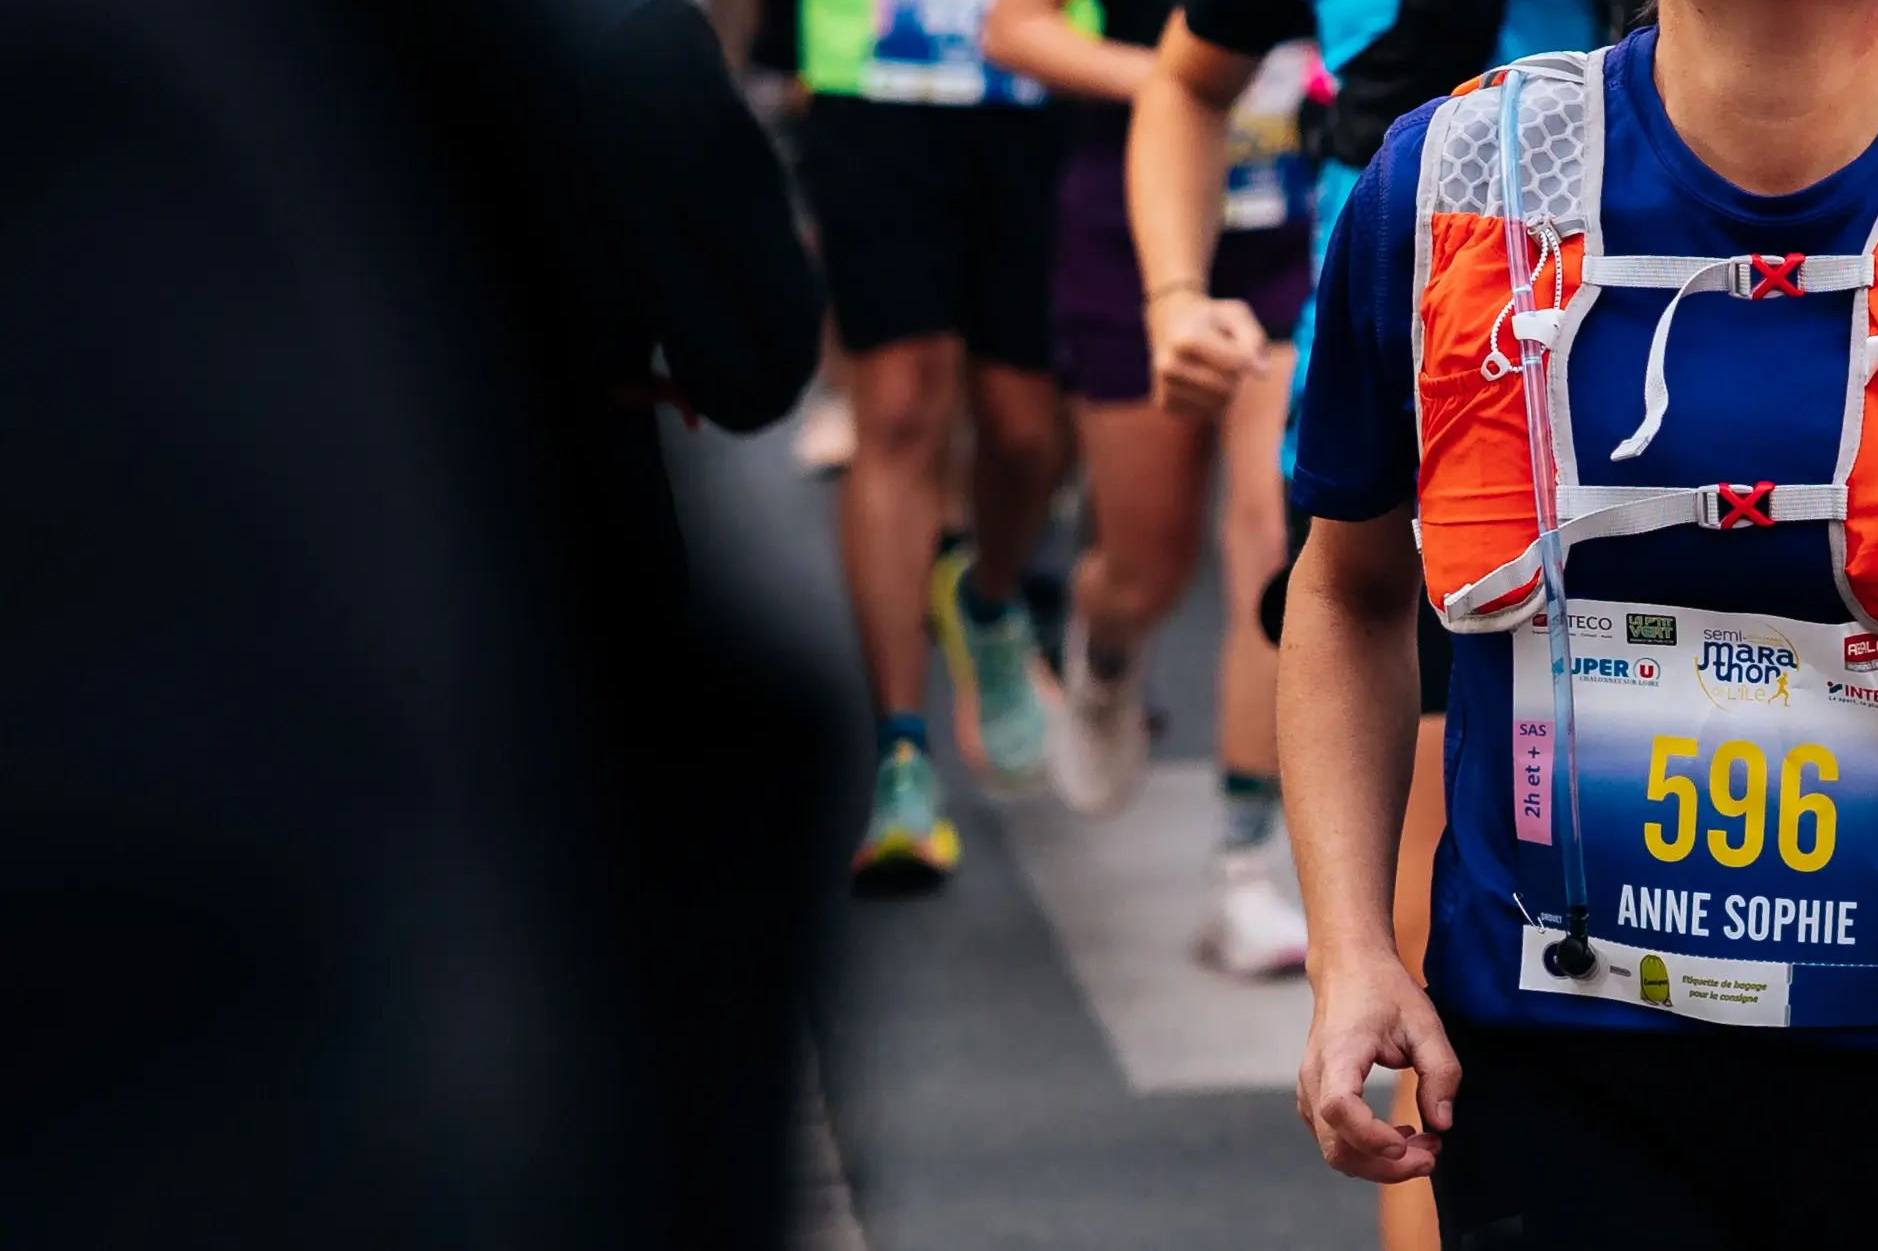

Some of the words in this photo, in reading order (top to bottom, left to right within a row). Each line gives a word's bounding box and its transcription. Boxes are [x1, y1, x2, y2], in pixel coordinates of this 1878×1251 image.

[1567, 615, 1613, 631] TECO
[1571, 658, 1629, 678] UPER
[1639, 665, 1654, 679] U
[1519, 723, 1547, 737] SAS
[1528, 766, 1540, 787] et
[1524, 792, 1541, 819] 2h
[1643, 735, 1840, 872] 596
[1617, 884, 1712, 937] ANNE
[1723, 895, 1858, 945] SOPHIE
